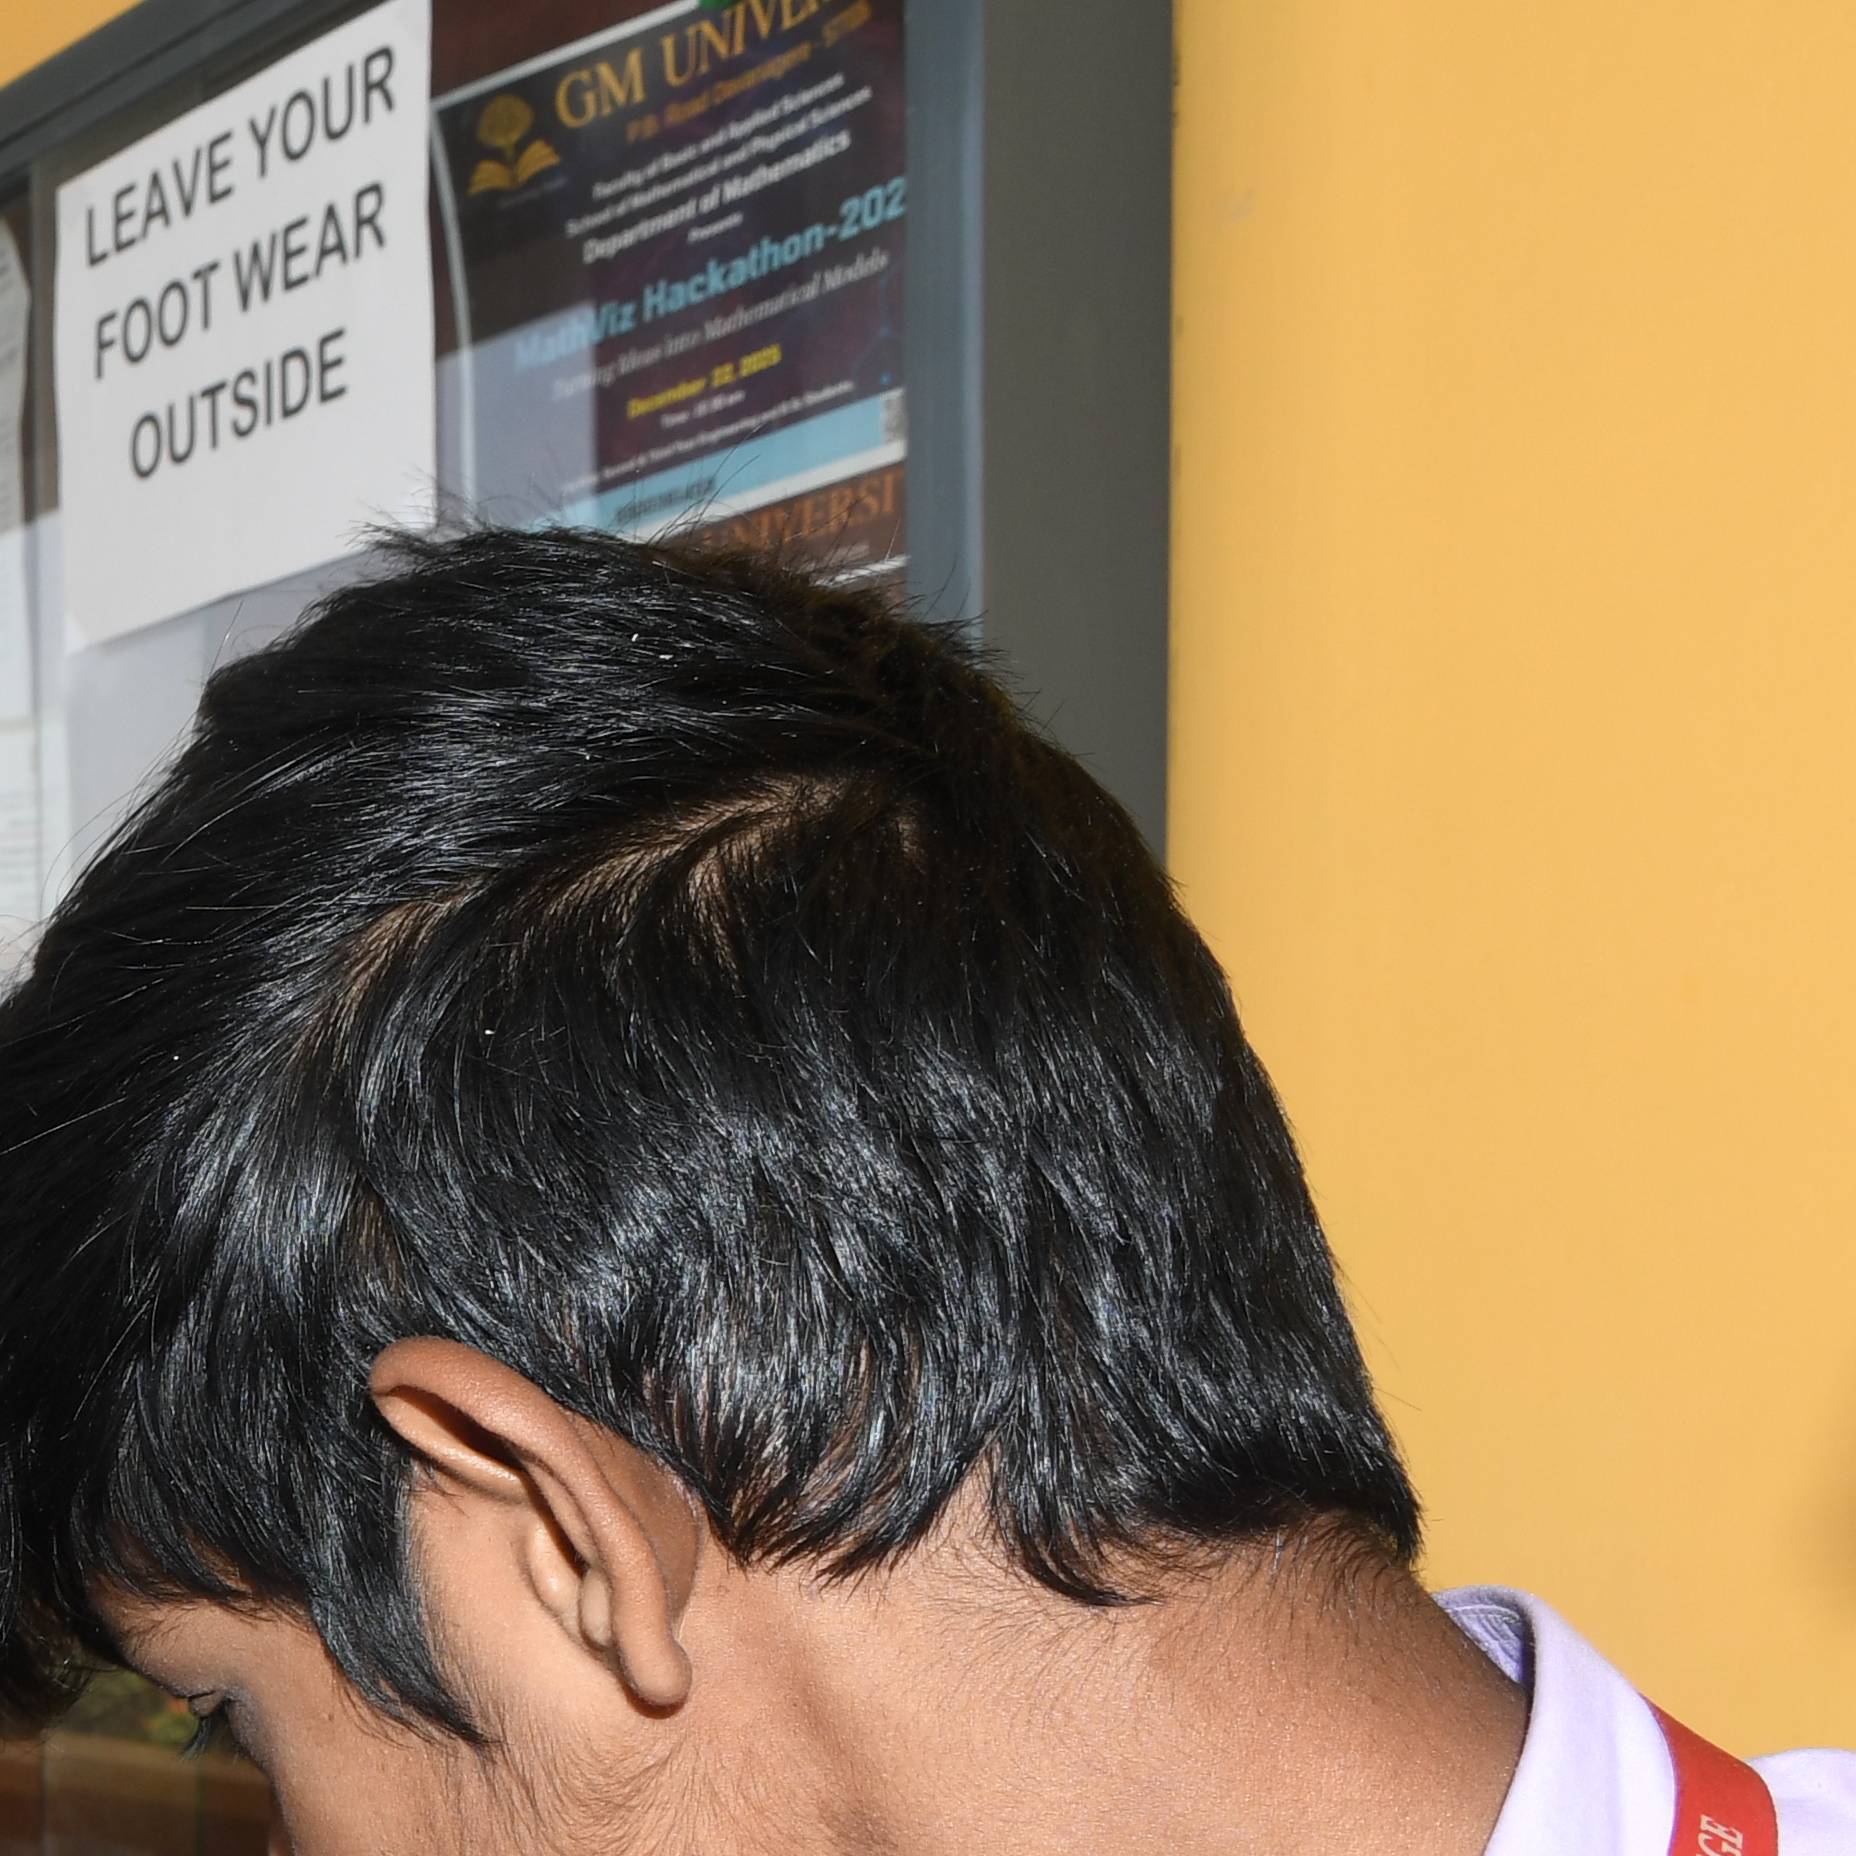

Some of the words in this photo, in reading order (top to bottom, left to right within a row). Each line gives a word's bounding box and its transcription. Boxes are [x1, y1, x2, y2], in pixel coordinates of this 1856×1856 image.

[554, 46, 646, 129] GM
[660, 0, 838, 88] UNIVE
[781, 71, 845, 114] Sciences
[809, 84, 873, 126] Sciences
[87, 128, 235, 268] LEAVE
[248, 46, 396, 179] YOUR
[582, 198, 698, 266] Department
[698, 182, 723, 215] of
[722, 129, 852, 205] Mathematics
[95, 260, 222, 381] FOOT
[232, 182, 386, 313] WEAR
[515, 298, 638, 371] MathViz
[641, 175, 908, 323] Hackathon-202
[702, 272, 822, 343] Mathematical
[130, 327, 348, 480] OUTSIDE
[626, 376, 708, 420] December
